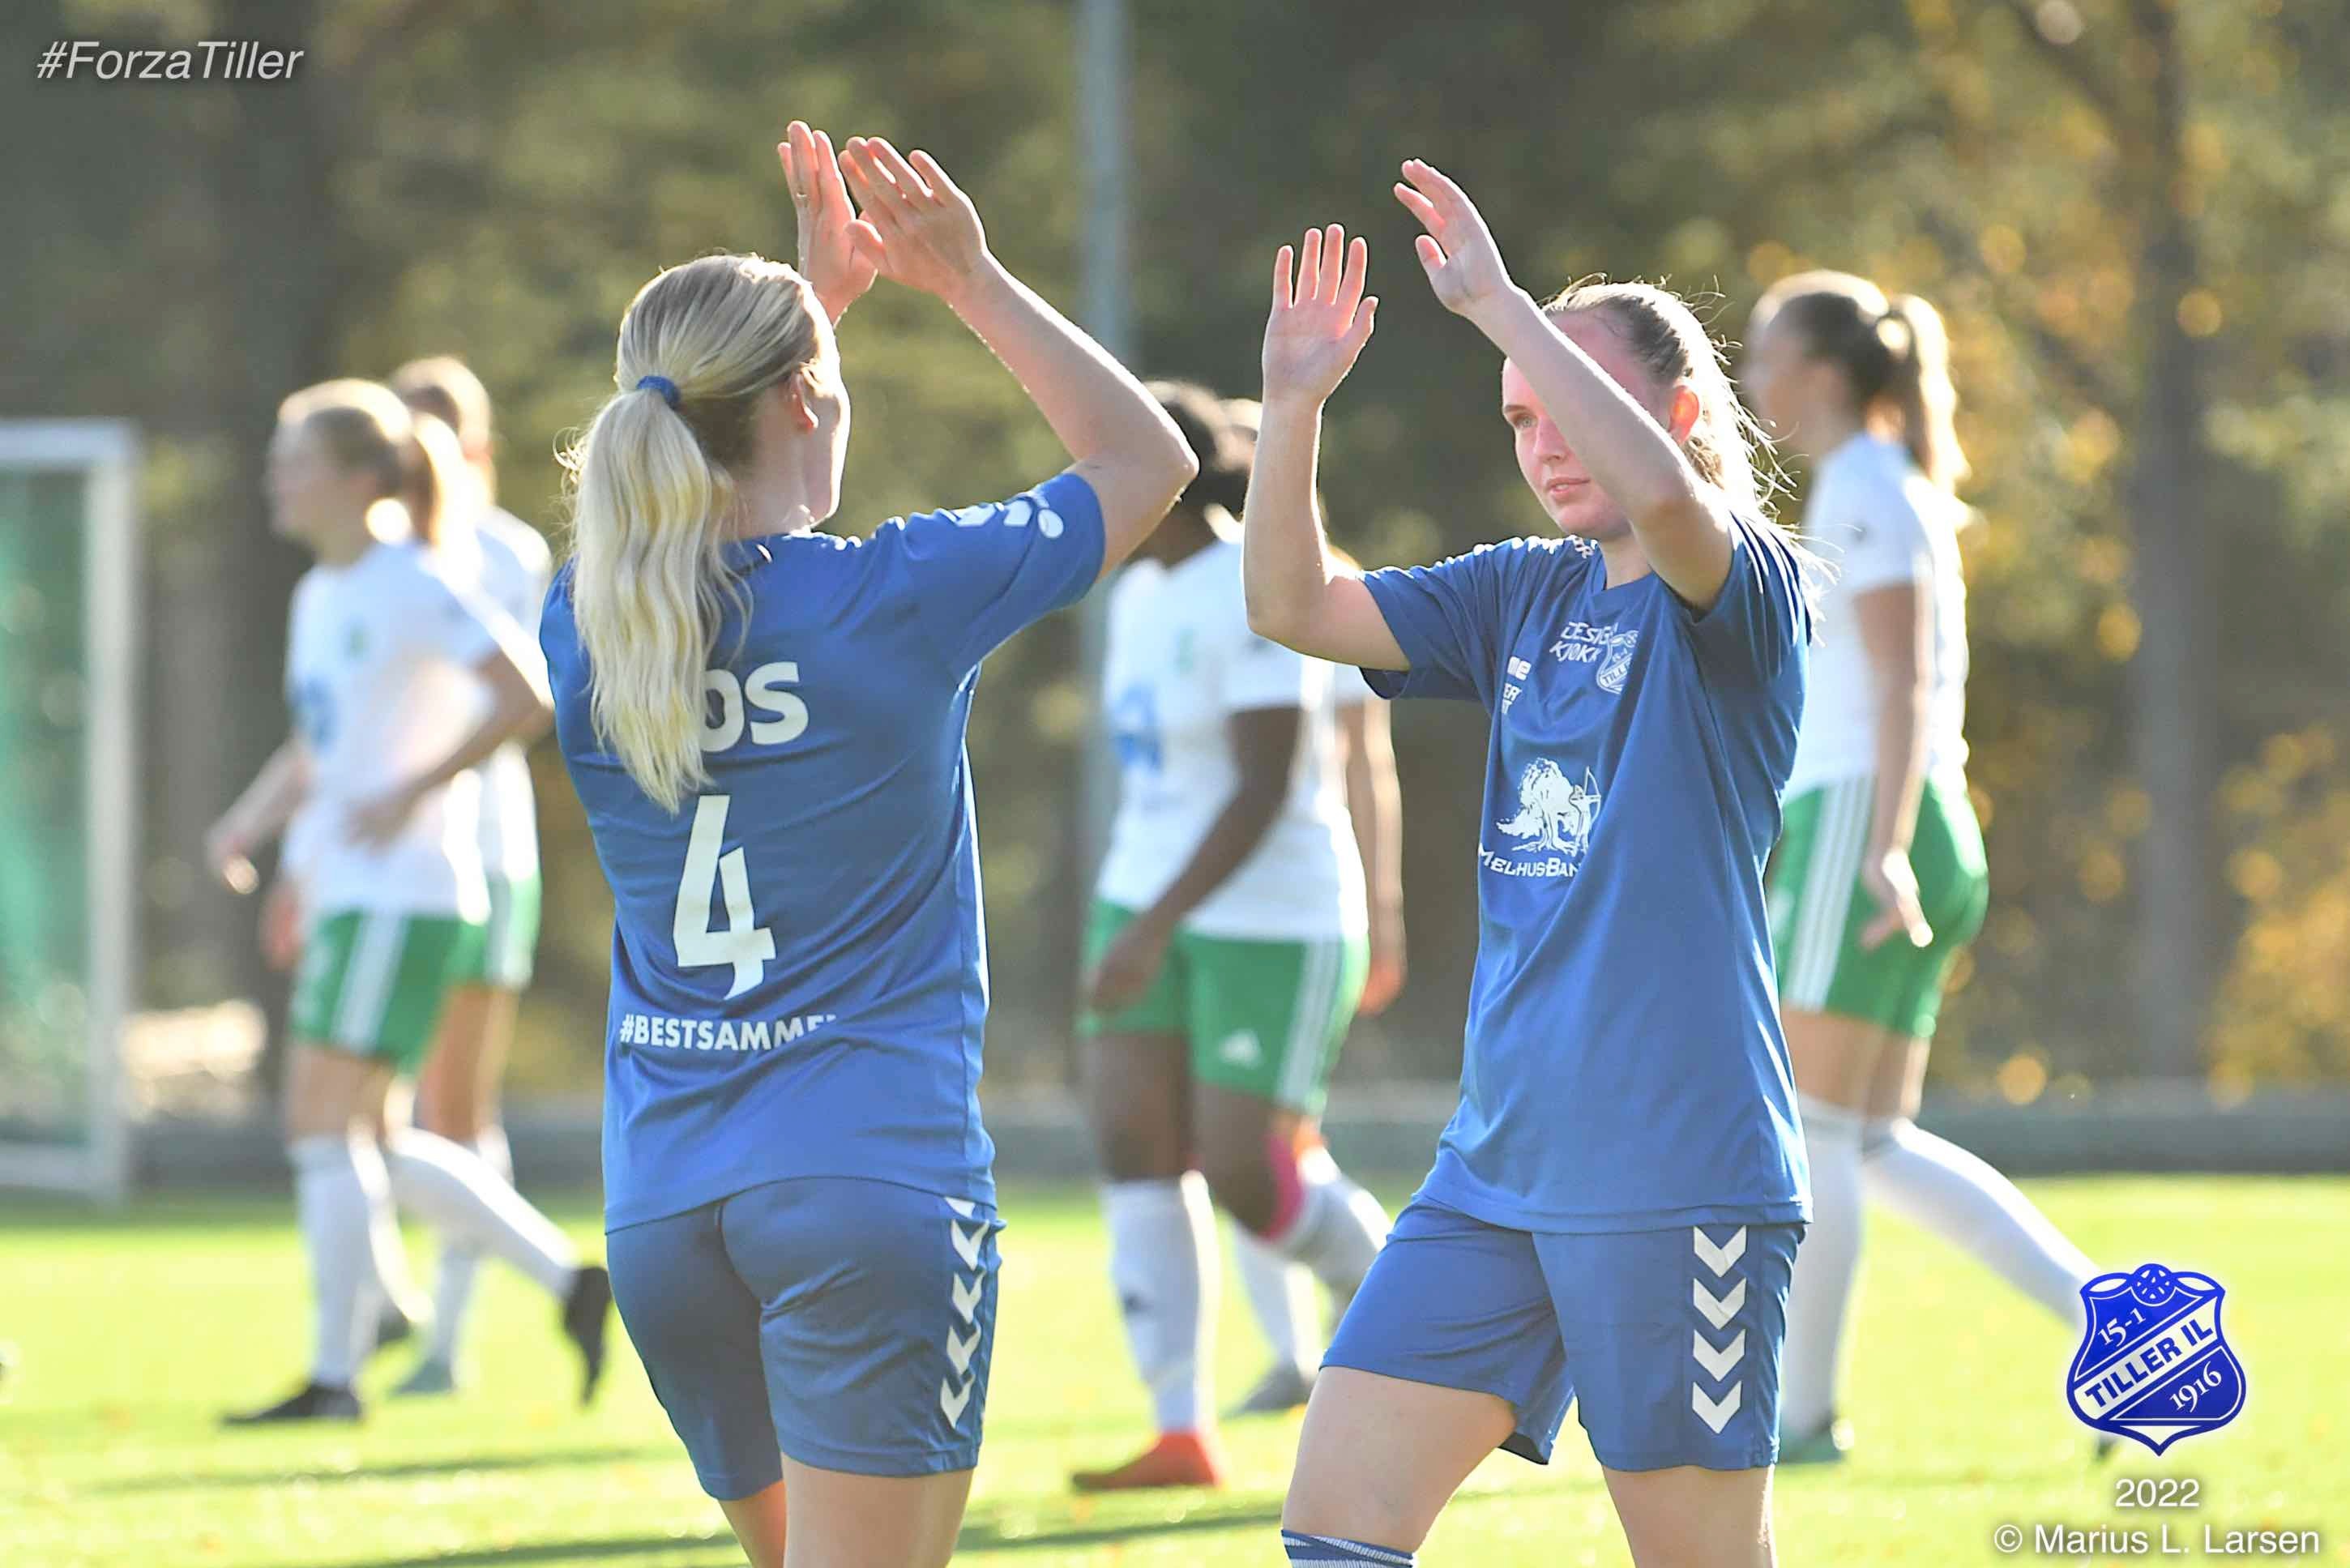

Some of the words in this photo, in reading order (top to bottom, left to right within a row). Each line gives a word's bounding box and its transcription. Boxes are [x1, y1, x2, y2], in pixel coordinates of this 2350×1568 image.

[699, 660, 809, 753] OS
[1477, 842, 1581, 877] MELHUSBAN
[673, 794, 776, 1000] 4
[620, 1013, 836, 1051] #BESTSAMME
